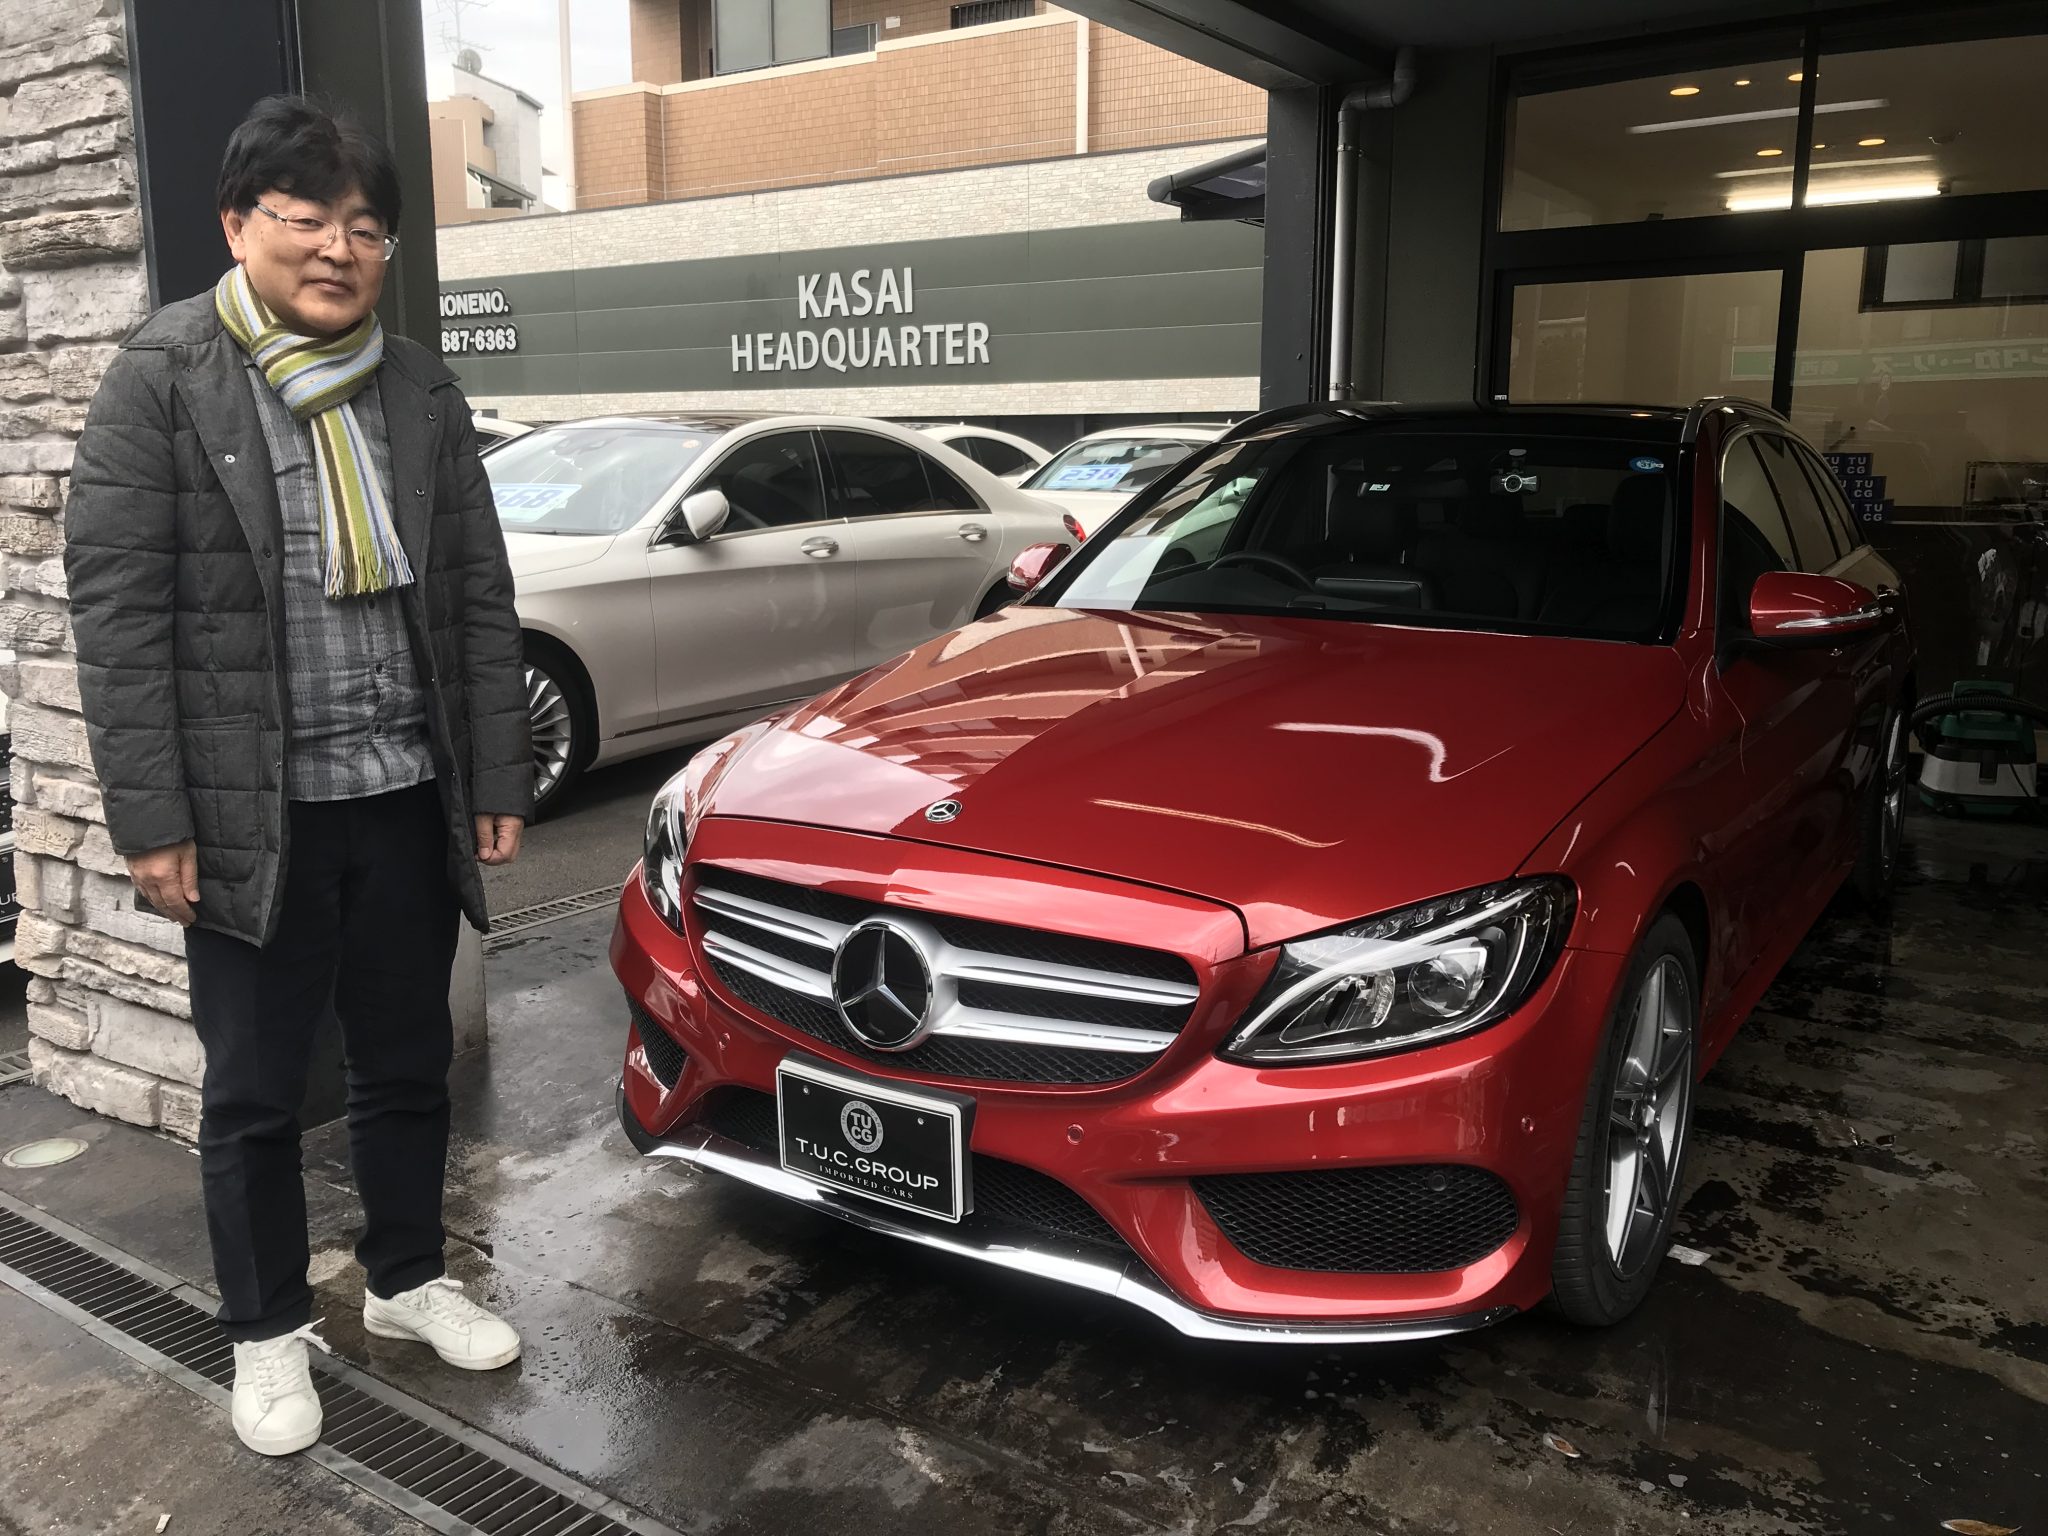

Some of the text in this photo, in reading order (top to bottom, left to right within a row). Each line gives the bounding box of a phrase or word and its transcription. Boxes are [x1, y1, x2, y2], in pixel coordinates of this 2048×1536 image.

[798, 267, 914, 319] KASAI
[731, 322, 991, 373] HEADQUARTER
[851, 1112, 871, 1128] TU
[852, 1126, 873, 1142] CG
[795, 1138, 939, 1189] T.U.C.GROUP
[819, 1165, 914, 1199] IMPORTED CARS
